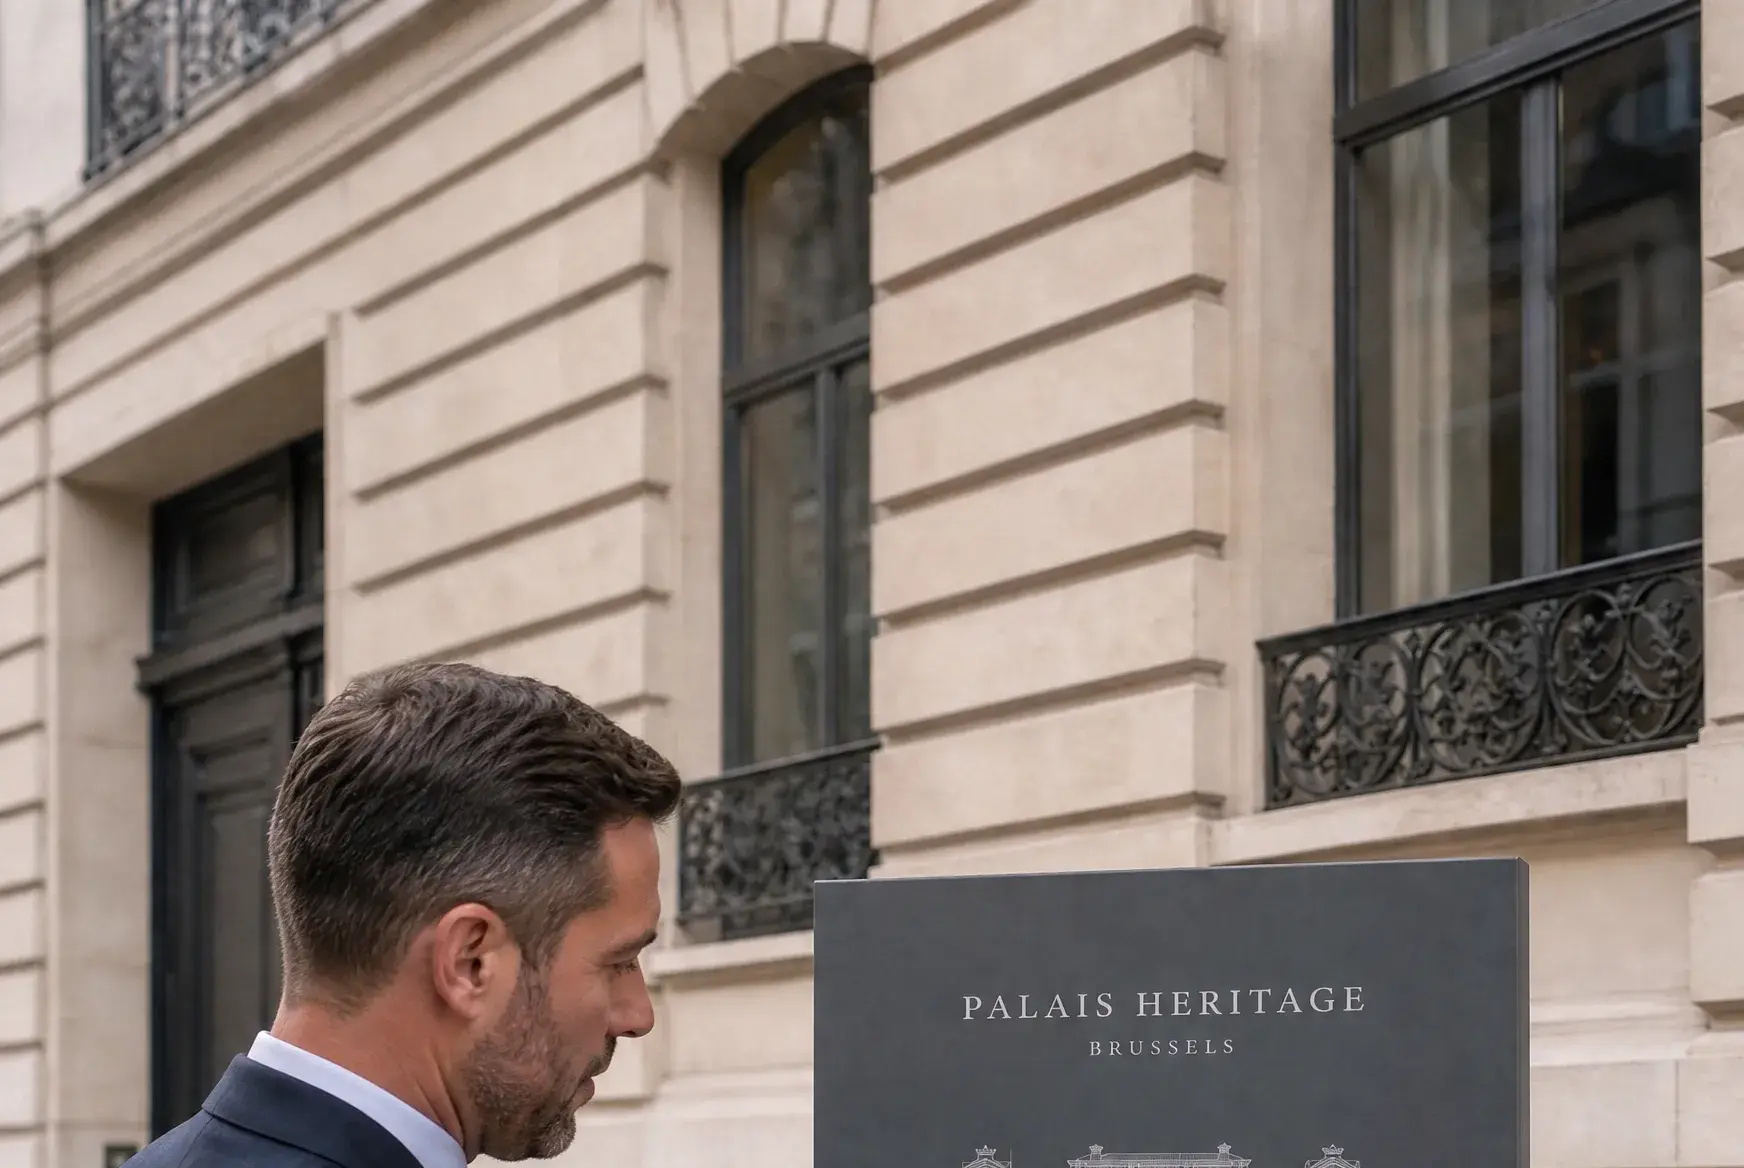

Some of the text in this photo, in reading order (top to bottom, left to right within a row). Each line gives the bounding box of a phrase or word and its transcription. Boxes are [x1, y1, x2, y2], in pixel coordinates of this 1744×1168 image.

[963, 986, 1365, 1020] PALAIS HERITAGE
[1089, 1038, 1234, 1056] BRUSSELS
